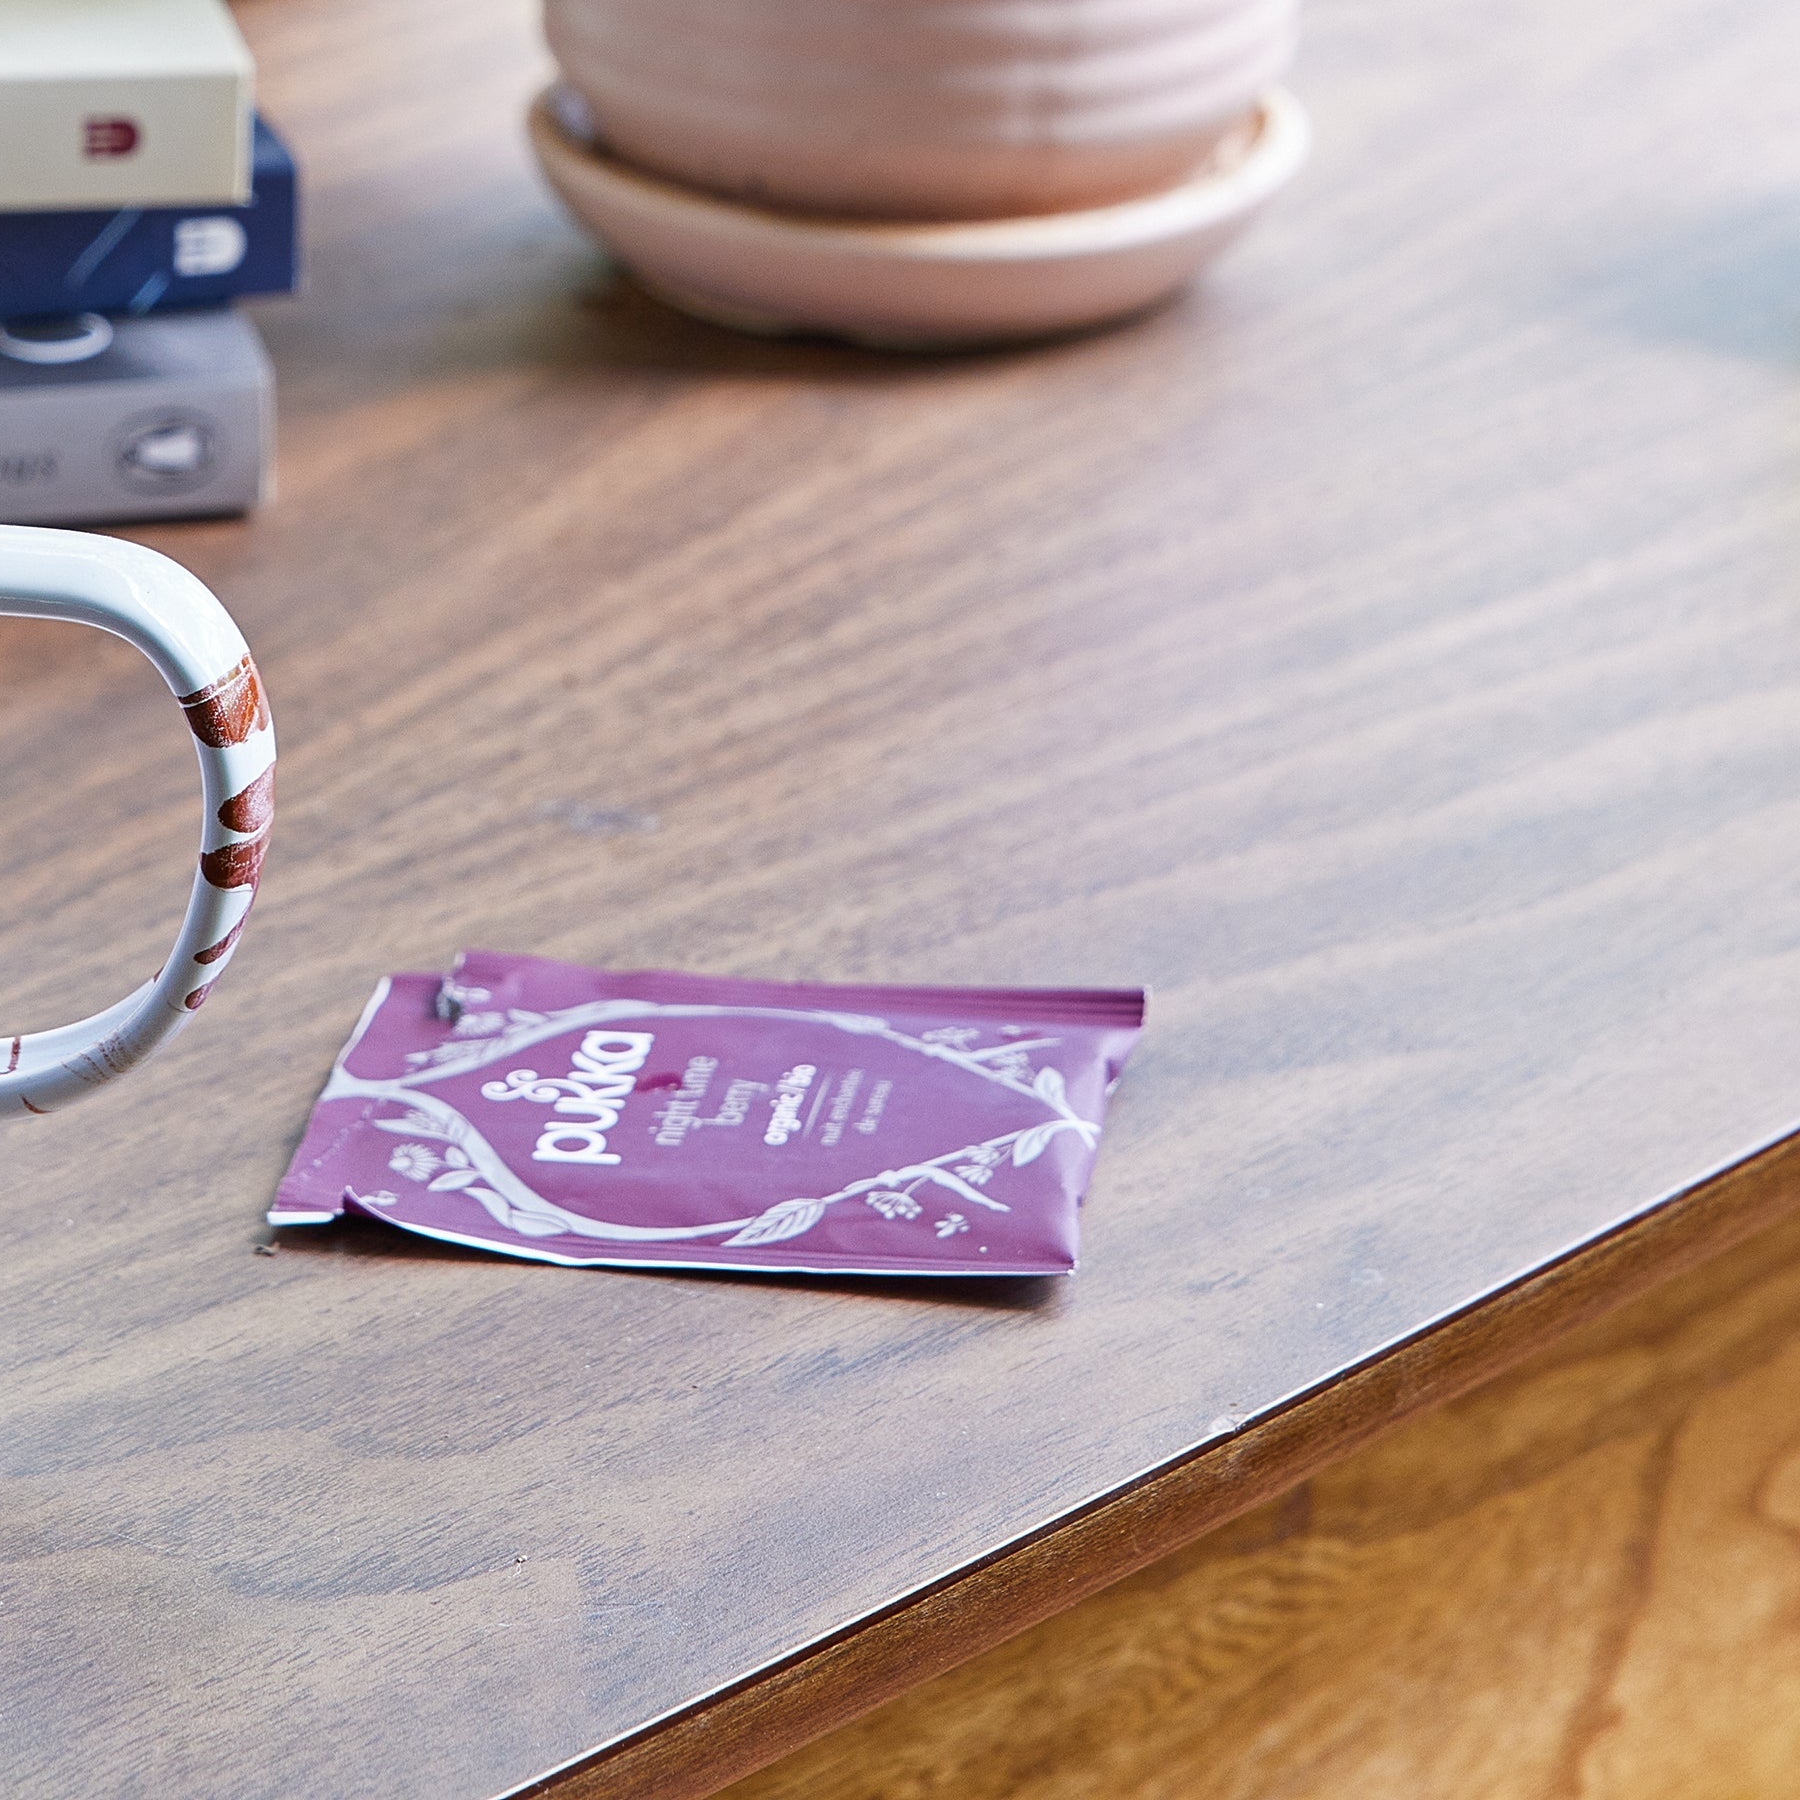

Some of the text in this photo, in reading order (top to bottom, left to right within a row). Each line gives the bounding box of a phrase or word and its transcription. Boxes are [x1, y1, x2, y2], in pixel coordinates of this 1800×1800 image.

[531, 1029, 654, 1165] pukka
[647, 1055, 720, 1147] night time
[693, 1078, 770, 1127] berry
